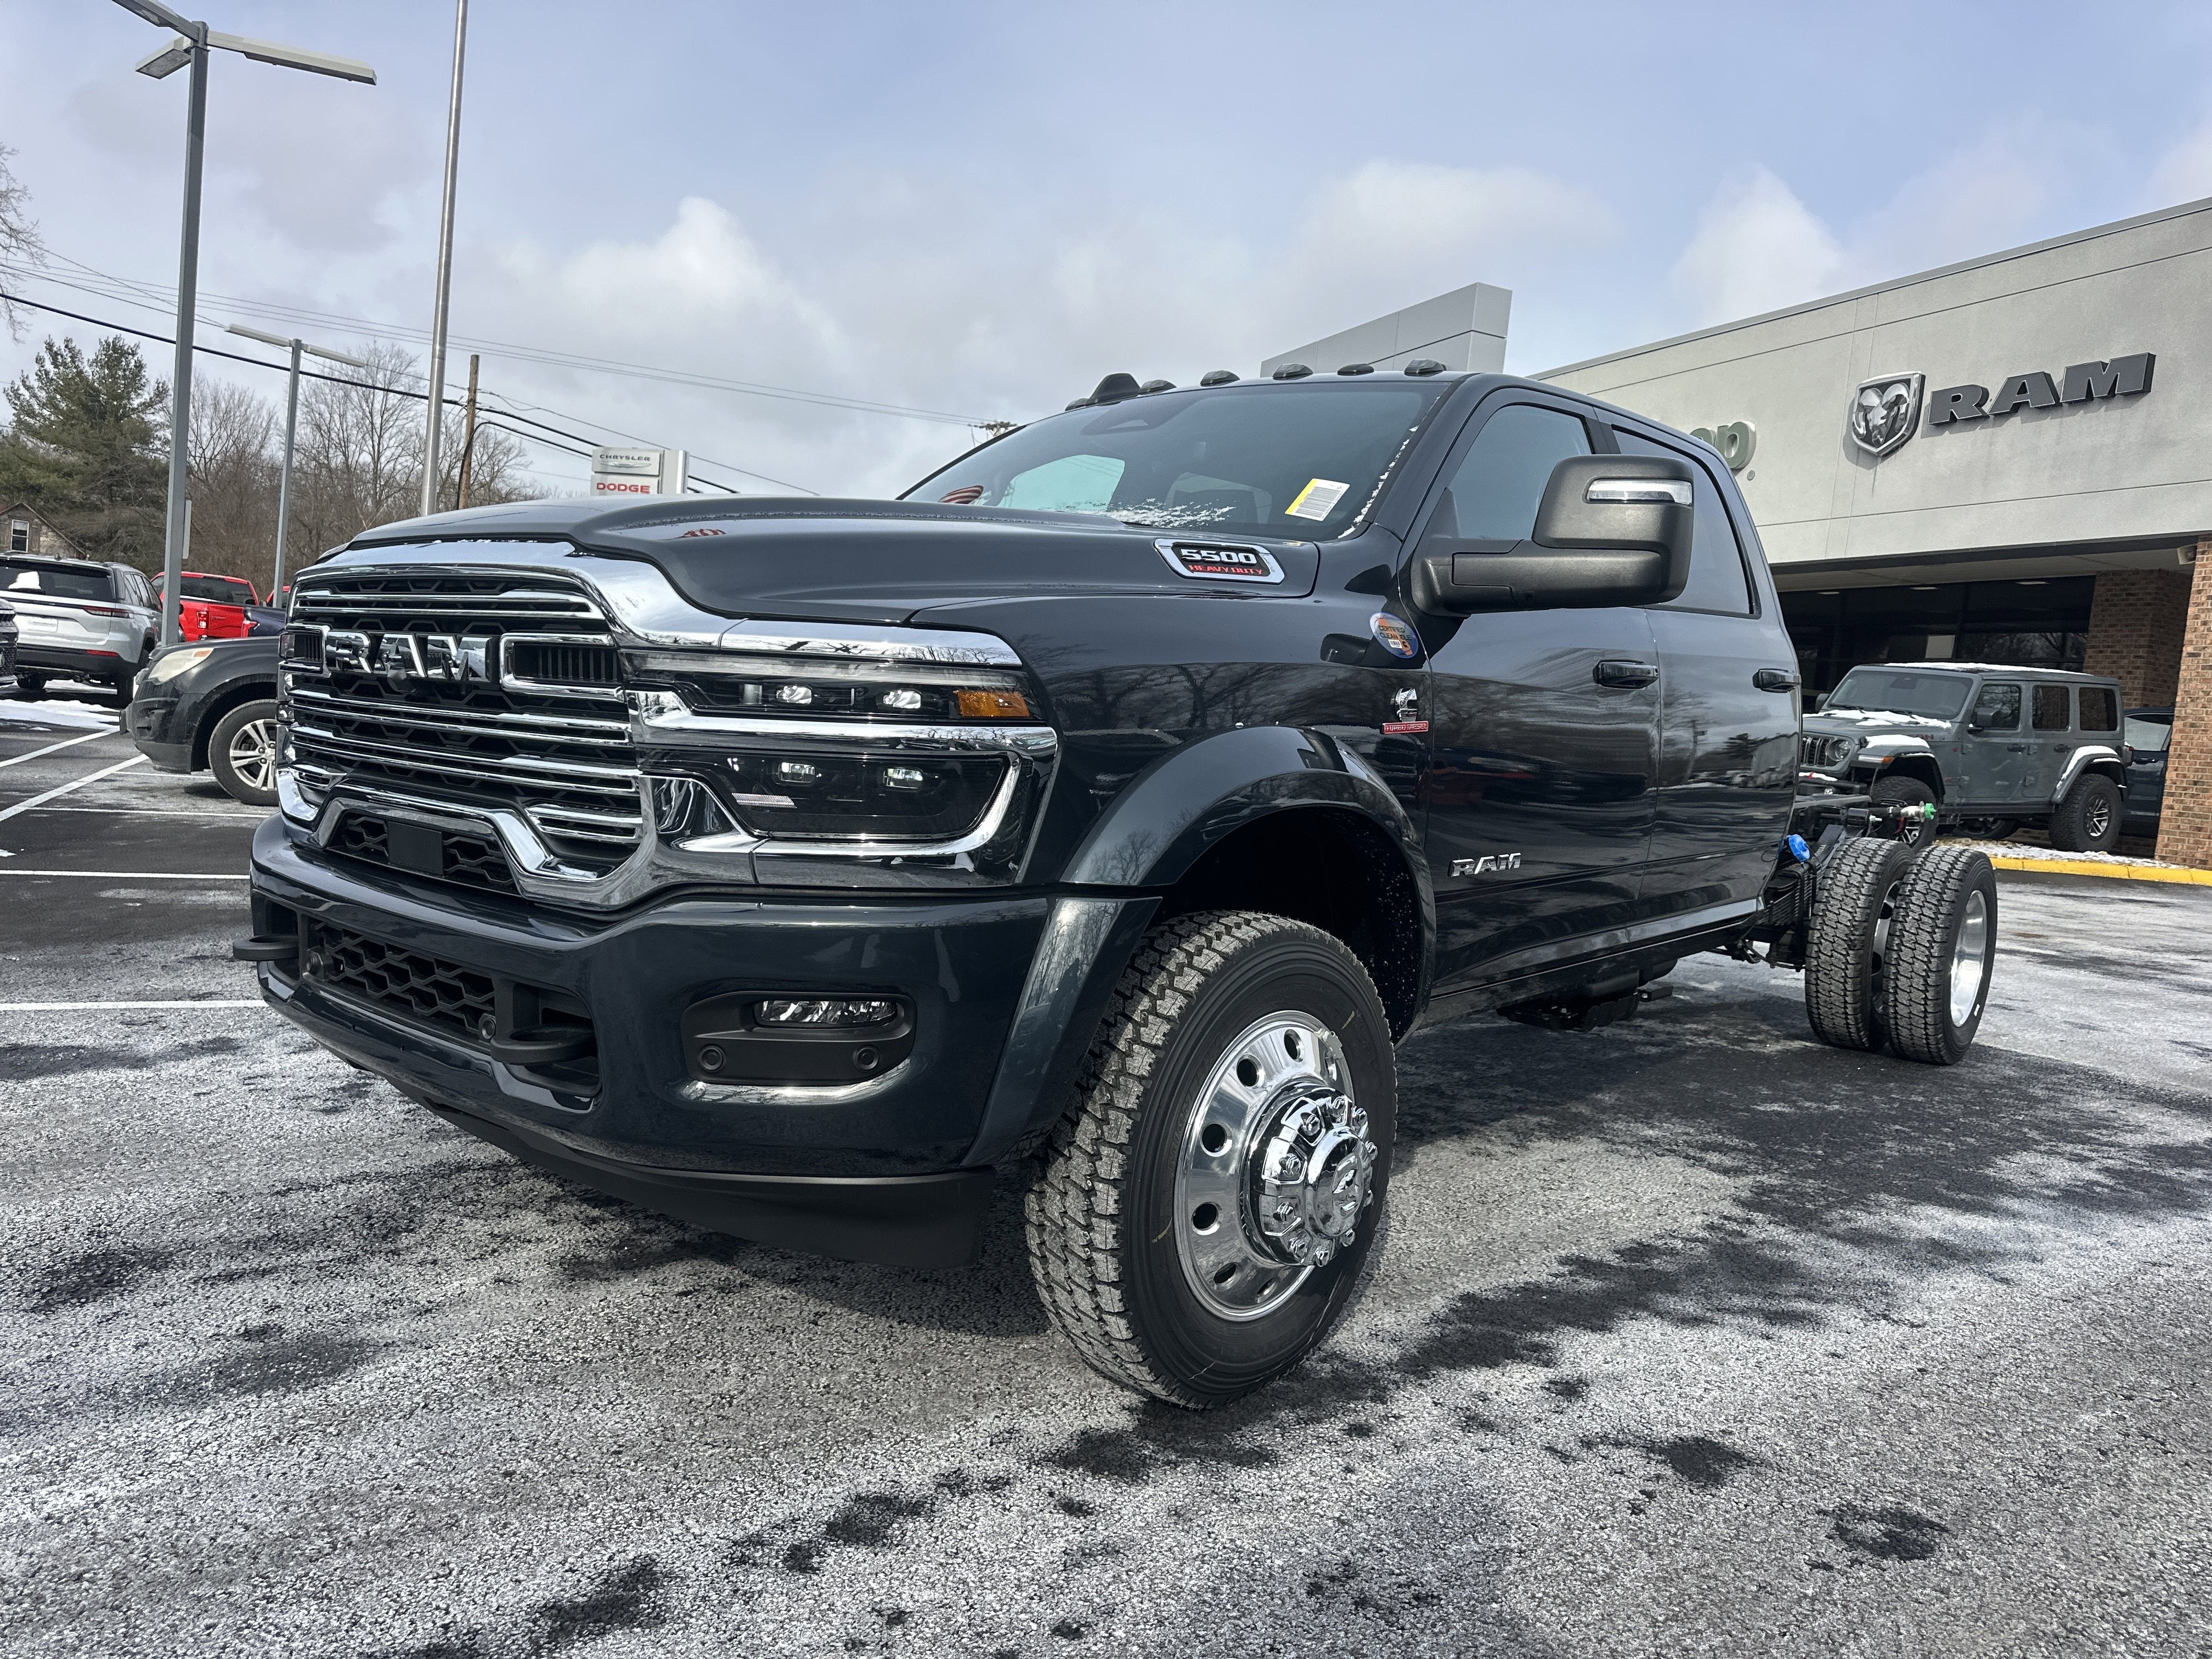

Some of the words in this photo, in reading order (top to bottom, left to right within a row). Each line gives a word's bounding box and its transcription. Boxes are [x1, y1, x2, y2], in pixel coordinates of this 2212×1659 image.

[1928, 352, 2156, 425] RAM
[596, 482, 651, 494] DODGE
[1180, 549, 1257, 565] 5500
[1188, 565, 1228, 573] HEAVY
[326, 630, 492, 683] RAM
[1447, 852, 1522, 878] RAM
